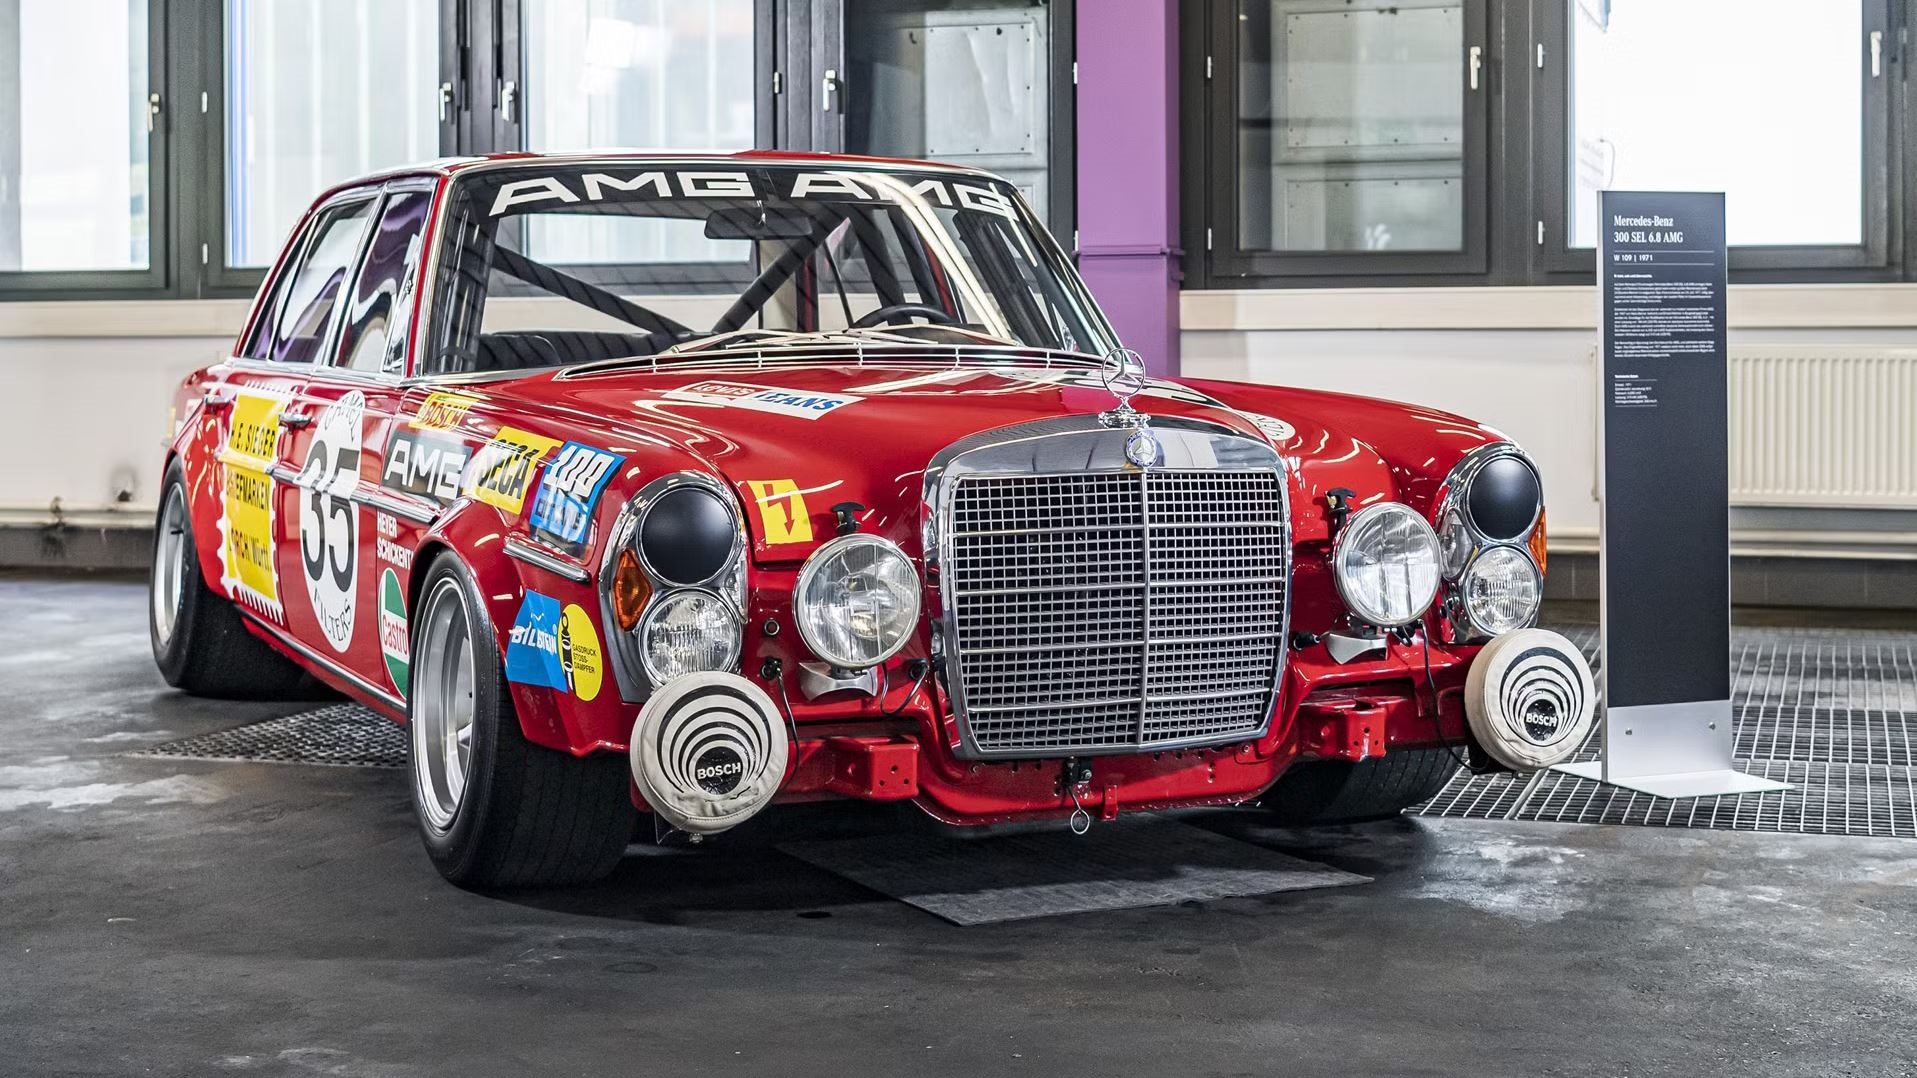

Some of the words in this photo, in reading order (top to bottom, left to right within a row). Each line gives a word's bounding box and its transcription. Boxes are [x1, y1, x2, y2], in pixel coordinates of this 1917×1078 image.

[488, 171, 756, 217] AMG
[790, 173, 1019, 221] AMG
[1613, 215, 1674, 227] Mercedes-Benz
[1613, 231, 1630, 243] 300
[1631, 231, 1647, 243] SEL
[1648, 231, 1662, 243] 6.8
[1663, 231, 1684, 243] AMG
[1613, 254, 1620, 262] W
[1621, 254, 1632, 262] 109
[1639, 254, 1653, 262] 1971
[422, 400, 467, 429] BOSCH
[750, 391, 844, 411] JEANS
[243, 423, 276, 459] SIEGER
[384, 439, 467, 500] AMG
[543, 445, 615, 498] 100
[300, 439, 360, 593] 35
[377, 511, 398, 539] HEYER
[313, 587, 353, 643] FILTERS
[382, 614, 408, 656] Castro
[511, 622, 558, 655] BILSTEIN
[572, 643, 597, 657] GASDRUCK
[1526, 712, 1557, 727] BOSCH
[697, 761, 742, 780] BOSCH
